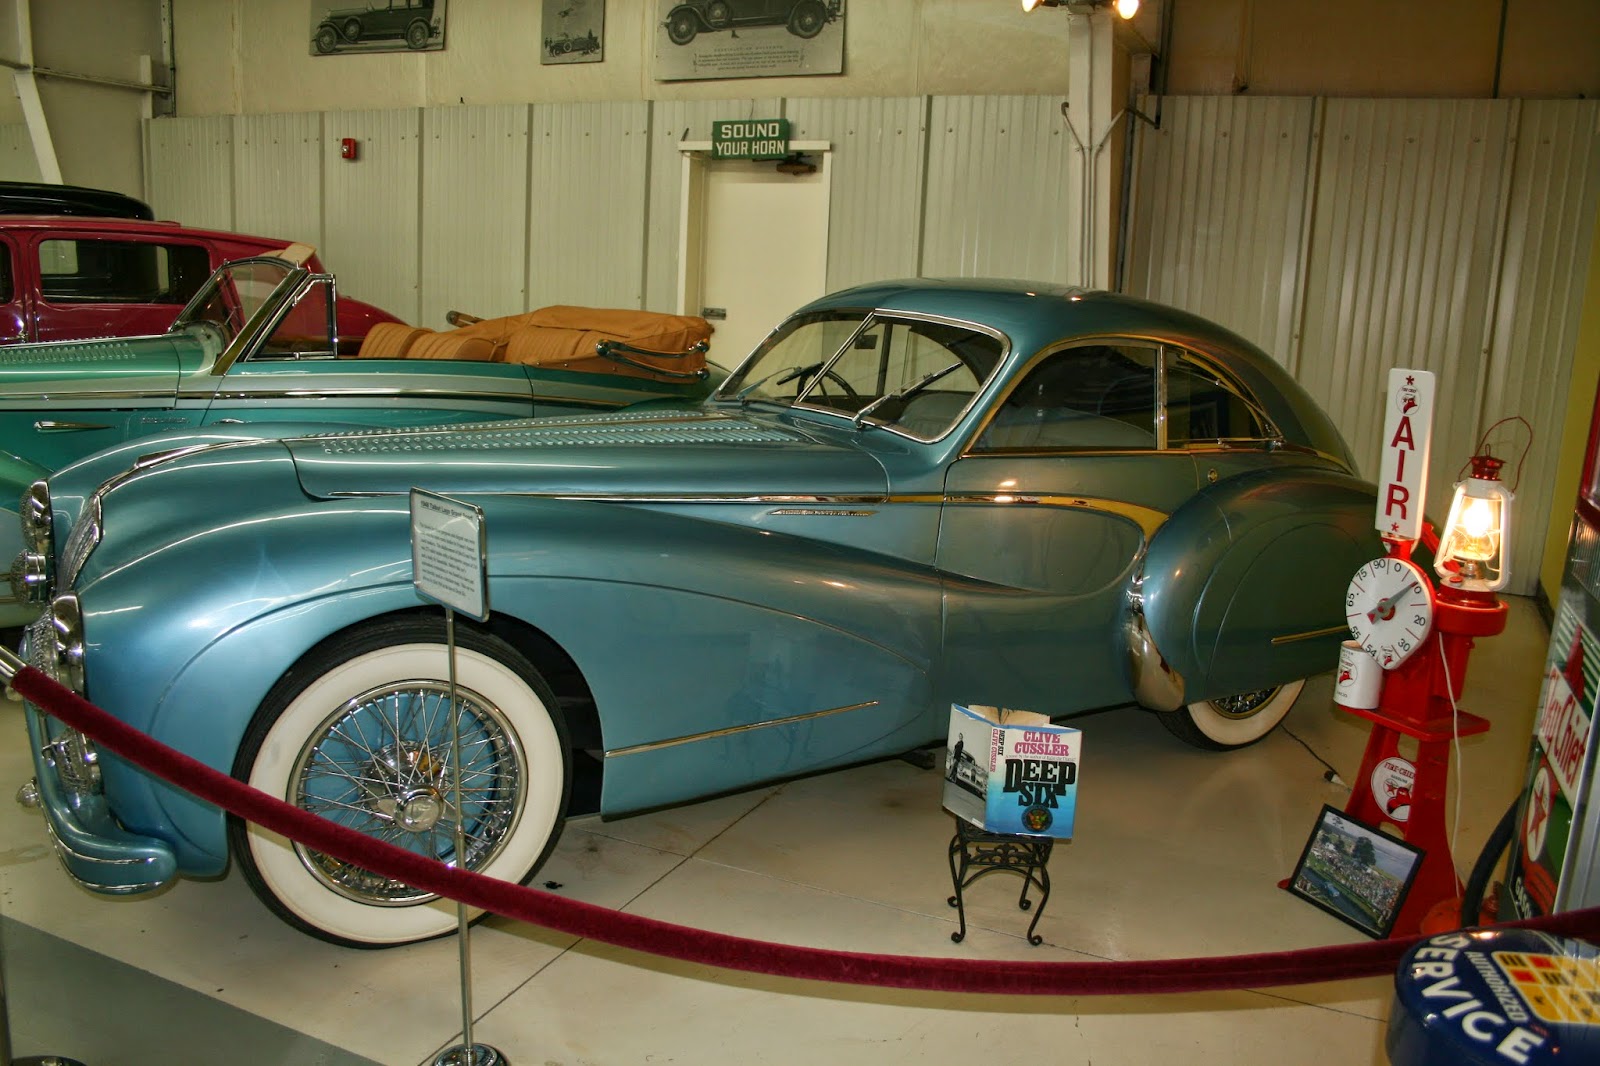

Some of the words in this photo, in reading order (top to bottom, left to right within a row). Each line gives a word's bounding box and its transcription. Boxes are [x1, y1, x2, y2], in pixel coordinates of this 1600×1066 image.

[721, 123, 780, 139] SOUND
[716, 141, 748, 156] YOUR
[752, 140, 785, 155] HORN
[1385, 415, 1415, 520] AIR
[1373, 559, 1386, 570] 90
[1394, 562, 1402, 573] 0
[1356, 568, 1368, 581] 75
[1346, 592, 1355, 607] 65
[1413, 614, 1426, 627] 20
[1350, 625, 1362, 640] 55
[1397, 638, 1411, 652] 30
[1023, 731, 1061, 744] CLIVE
[1014, 742, 1070, 757] CUSSLER
[1003, 759, 1076, 796] DEEP
[1018, 781, 1059, 809] SIX
[1464, 951, 1529, 1022] AUTHORIZED
[1411, 935, 1545, 1065] SERVICE
